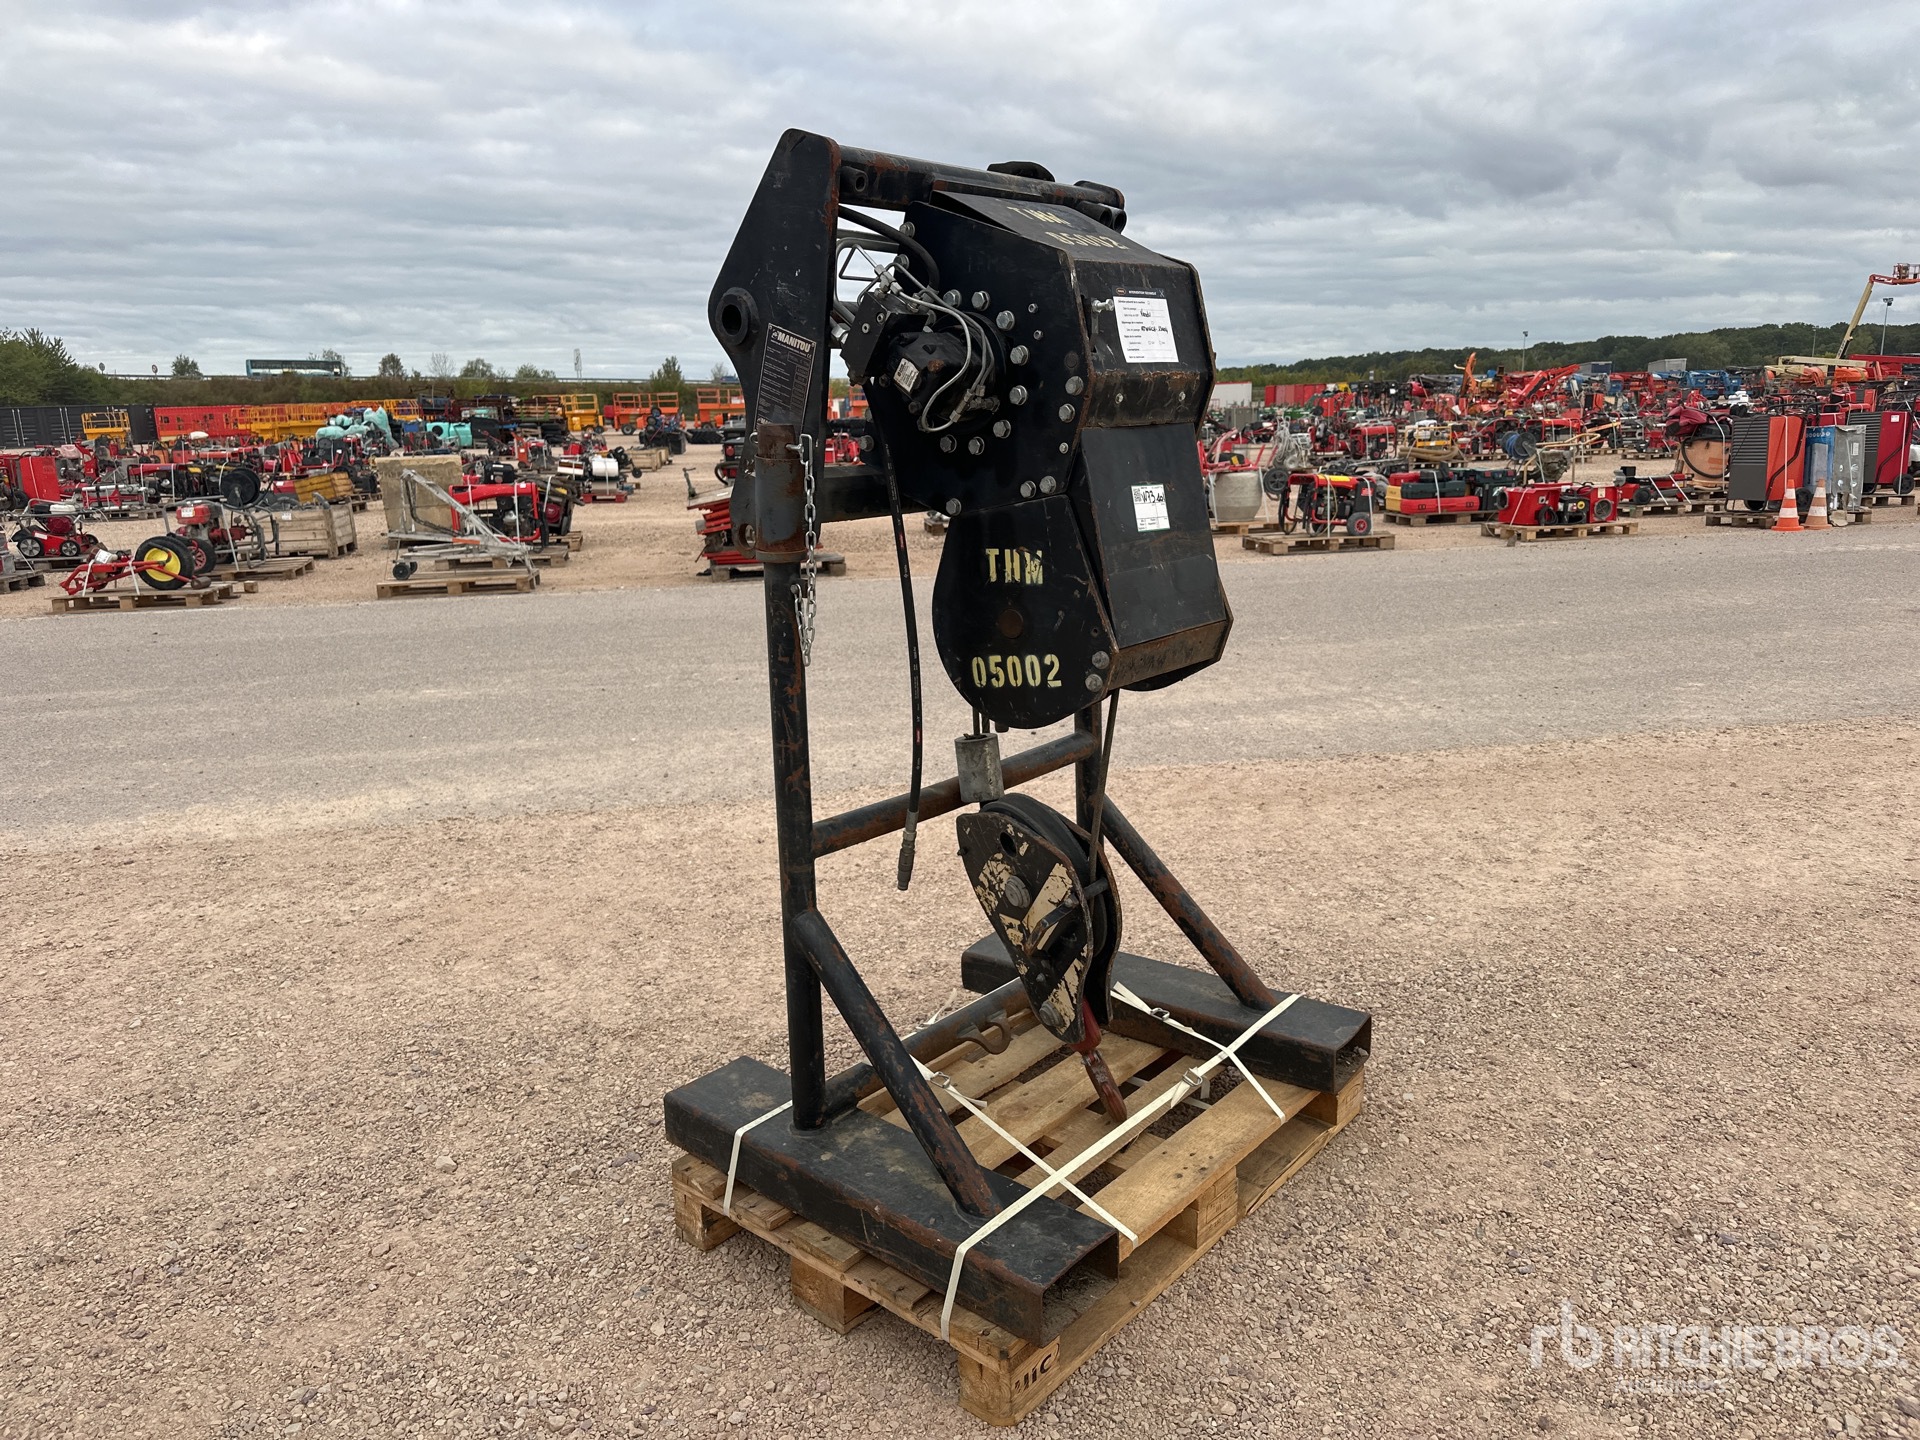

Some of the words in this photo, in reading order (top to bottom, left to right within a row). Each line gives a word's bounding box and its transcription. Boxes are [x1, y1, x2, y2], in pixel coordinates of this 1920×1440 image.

[1045, 231, 1130, 250] 05002
[777, 331, 811, 352] MANITOU
[985, 548, 1044, 585] THM
[971, 653, 1062, 688] 05002
